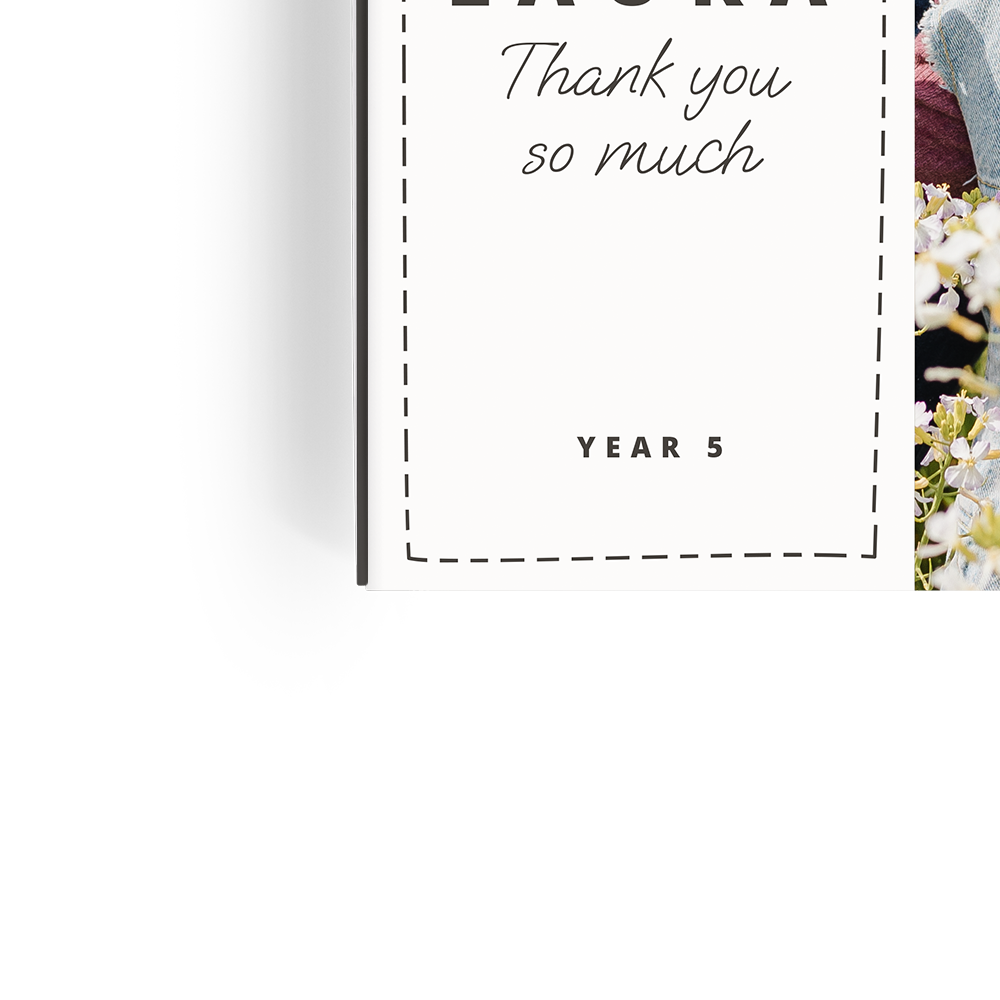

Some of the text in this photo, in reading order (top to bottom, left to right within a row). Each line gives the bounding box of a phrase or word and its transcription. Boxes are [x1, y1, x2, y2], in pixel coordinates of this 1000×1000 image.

[501, 37, 792, 122] Thank you
[521, 119, 765, 177] so much
[576, 436, 723, 458] YEAR 5
